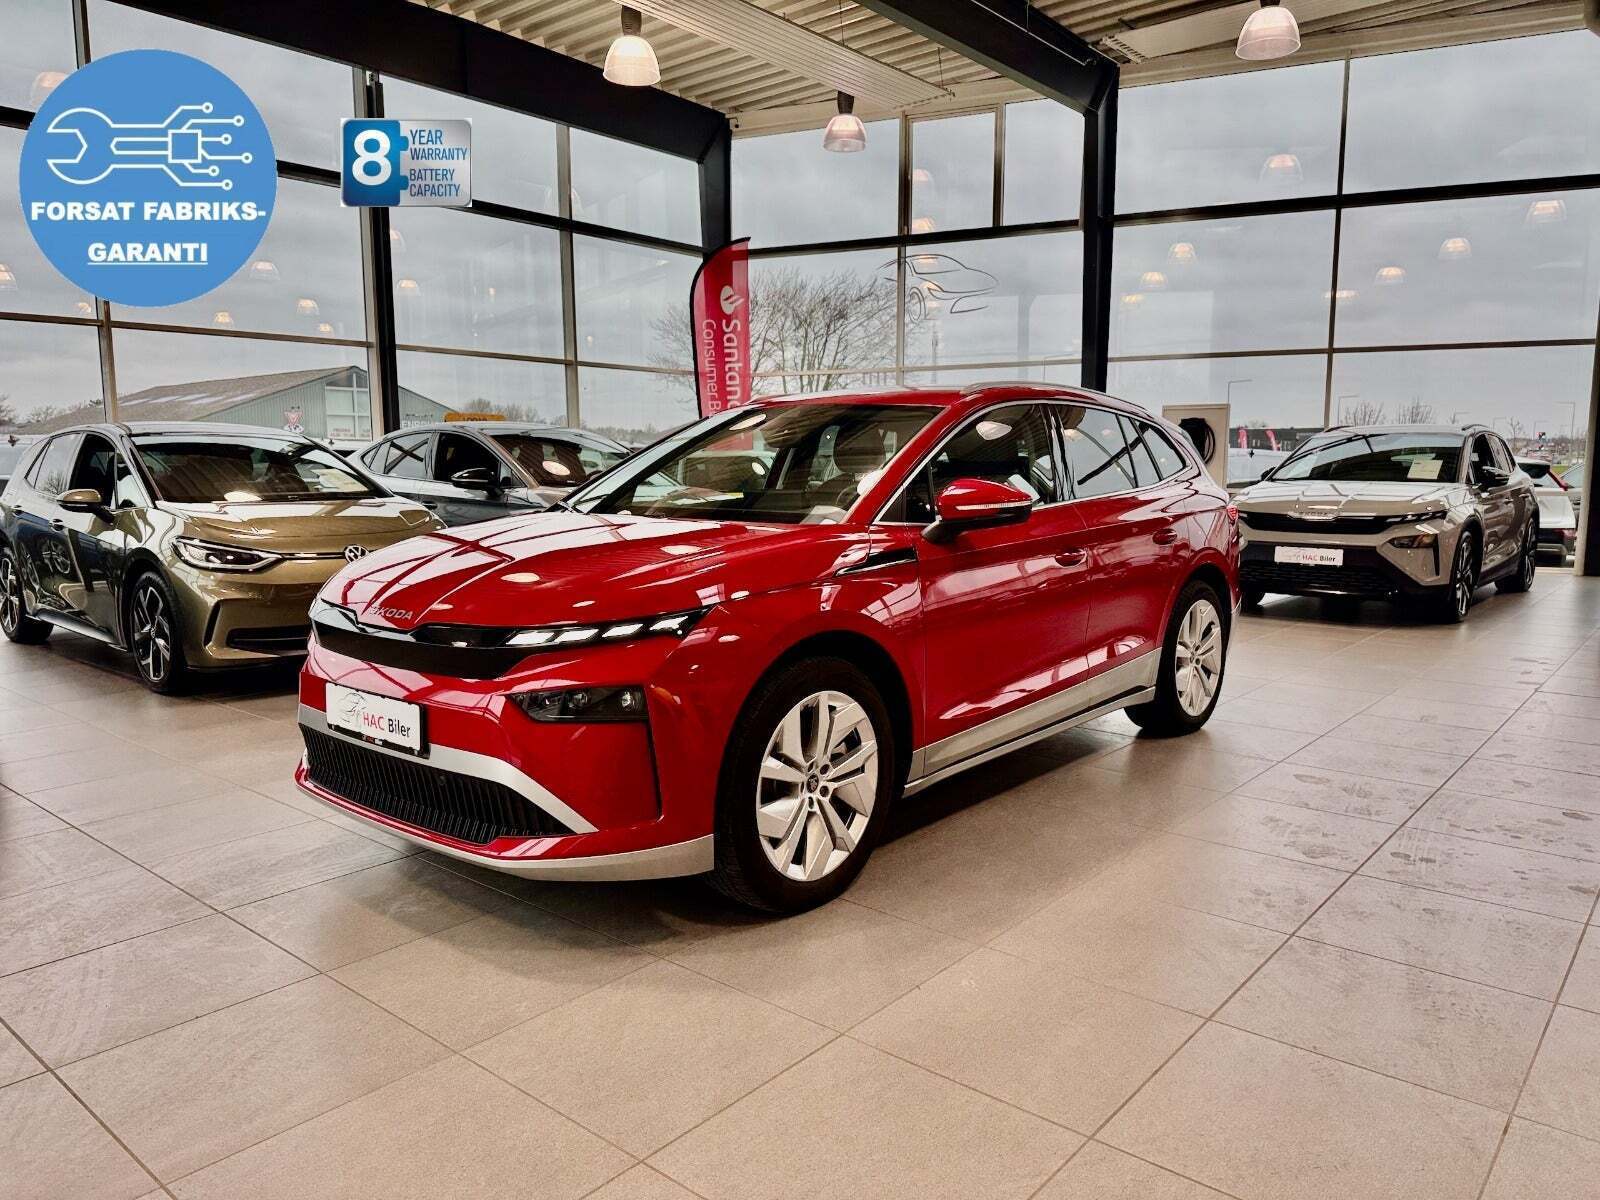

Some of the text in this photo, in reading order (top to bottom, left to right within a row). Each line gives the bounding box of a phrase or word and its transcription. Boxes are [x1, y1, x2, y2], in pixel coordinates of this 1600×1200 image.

[702, 319, 718, 399] Consumer
[1320, 554, 1336, 562] Biler
[363, 712, 411, 738] HAC Biler
